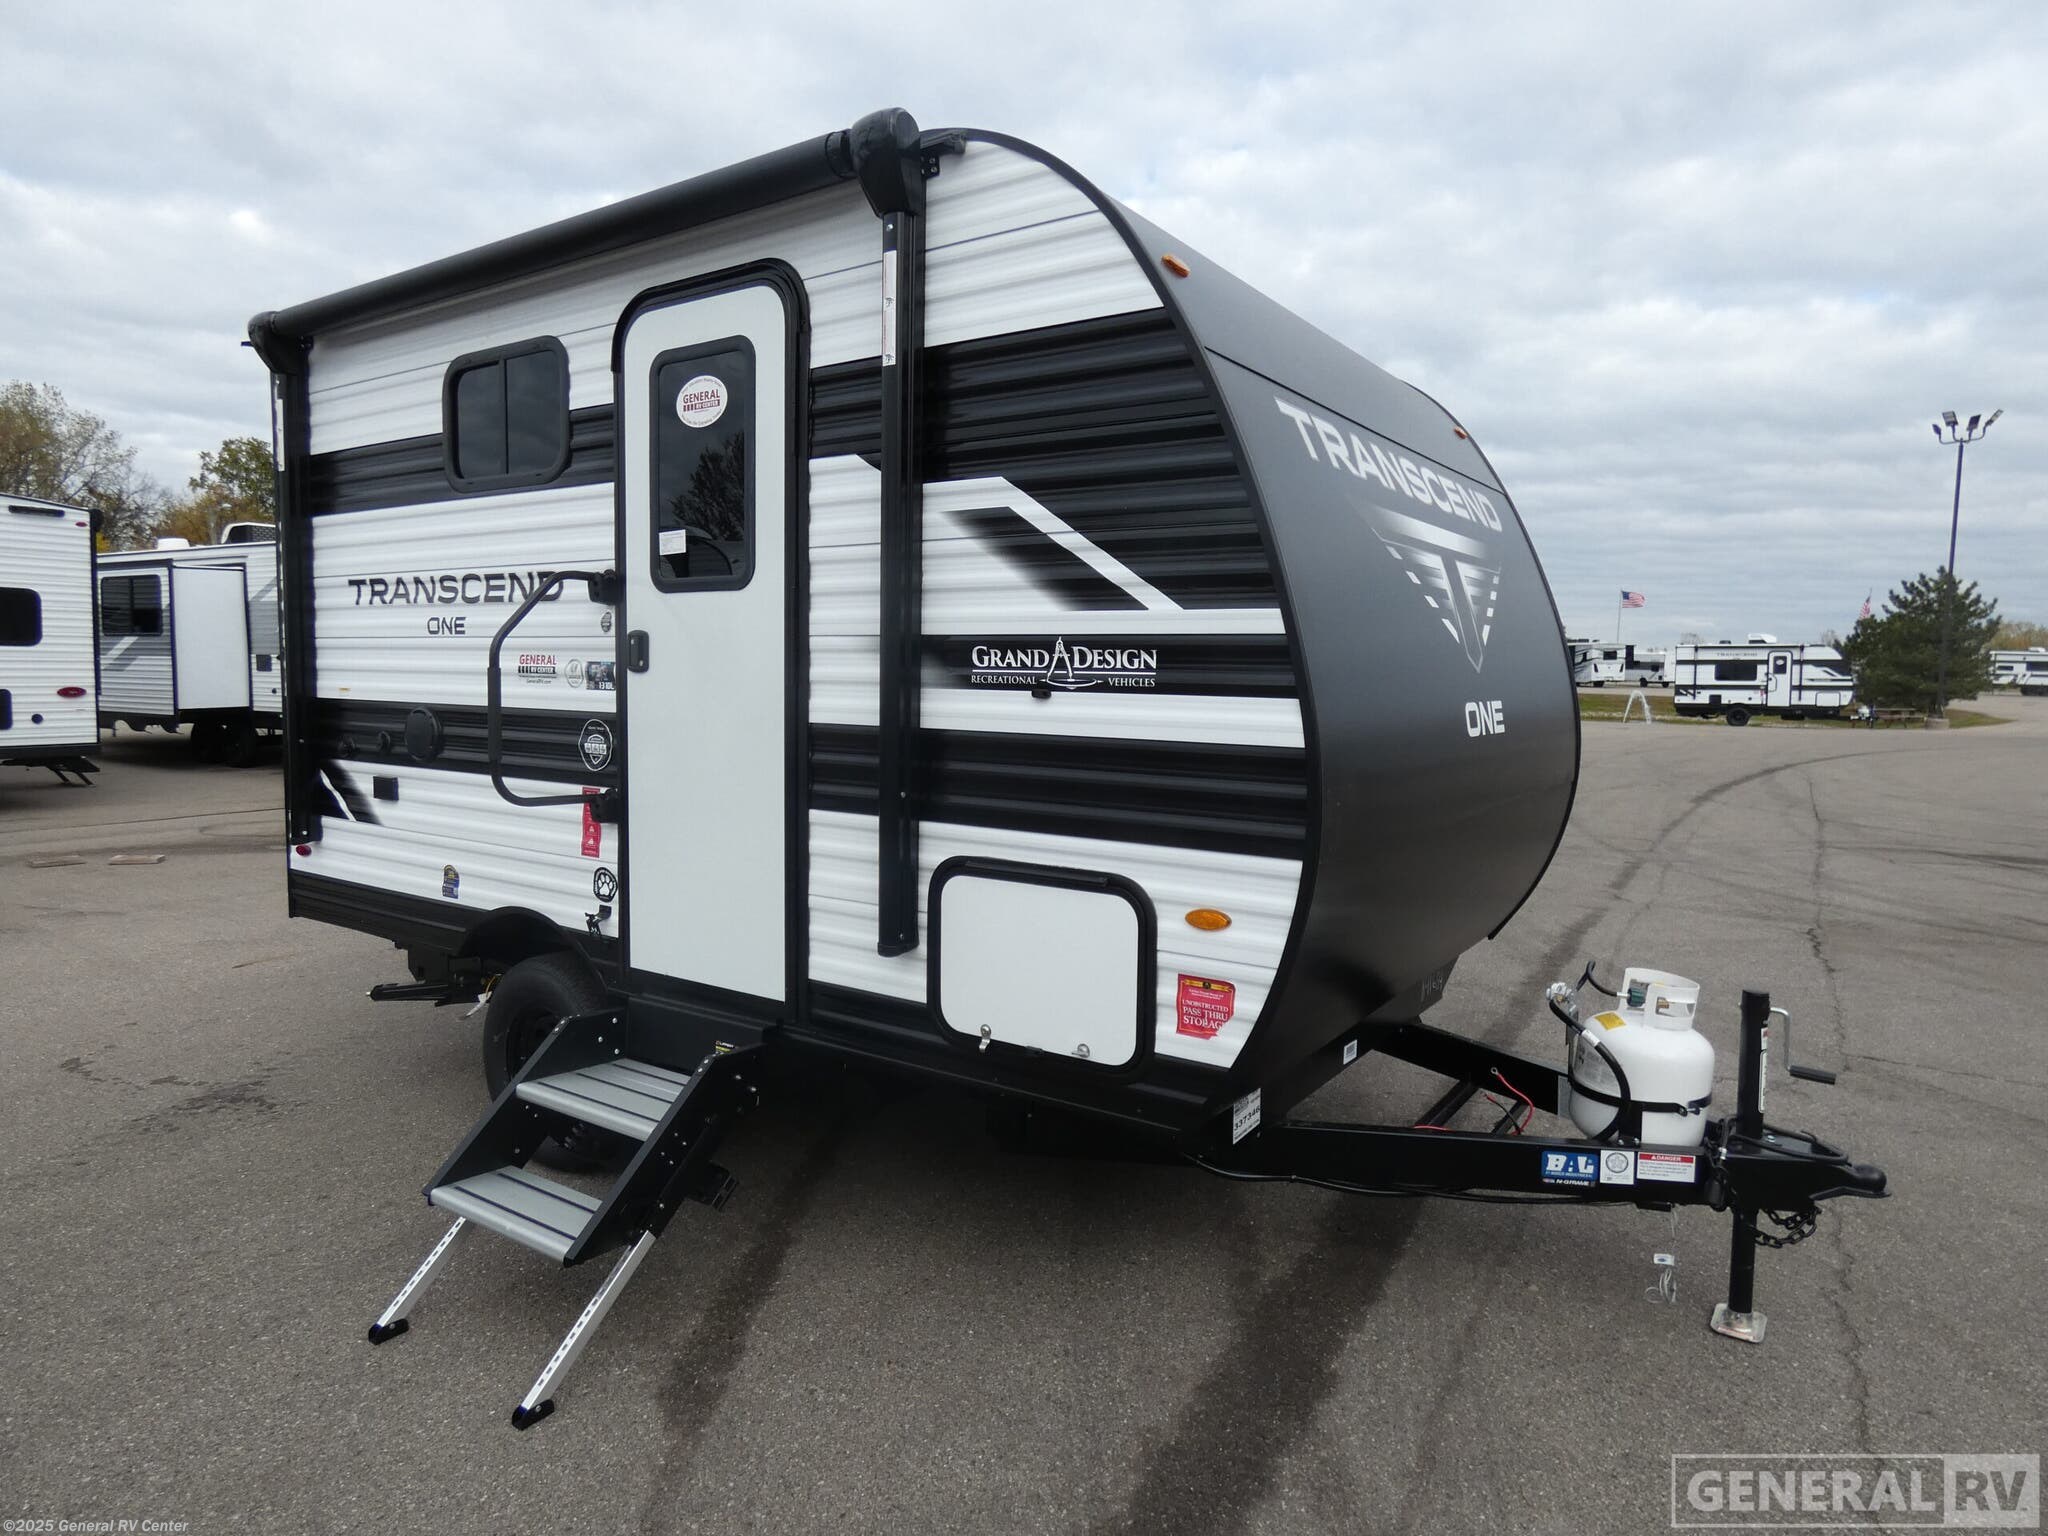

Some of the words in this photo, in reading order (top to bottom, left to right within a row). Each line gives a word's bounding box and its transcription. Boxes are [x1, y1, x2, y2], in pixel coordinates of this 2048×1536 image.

[683, 389, 720, 404] GENERAL
[1274, 395, 1503, 533] TRANSCEND
[348, 571, 564, 606] TRANSCEND
[427, 616, 466, 635] ONE
[519, 654, 557, 665] GENERAL
[972, 645, 1050, 668] GRAND
[1071, 646, 1158, 669] DESIGN
[971, 675, 1038, 685] RECREATIONAL
[1108, 677, 1156, 688] VEHICLES
[1465, 700, 1506, 738] ONE
[1182, 999, 1229, 1013] UNOBSTRUCTED
[1183, 1006, 1202, 1017] PASS
[1203, 1009, 1228, 1021] THRU
[1183, 1015, 1224, 1029] STORAG
[1546, 1153, 1594, 1174] BAL
